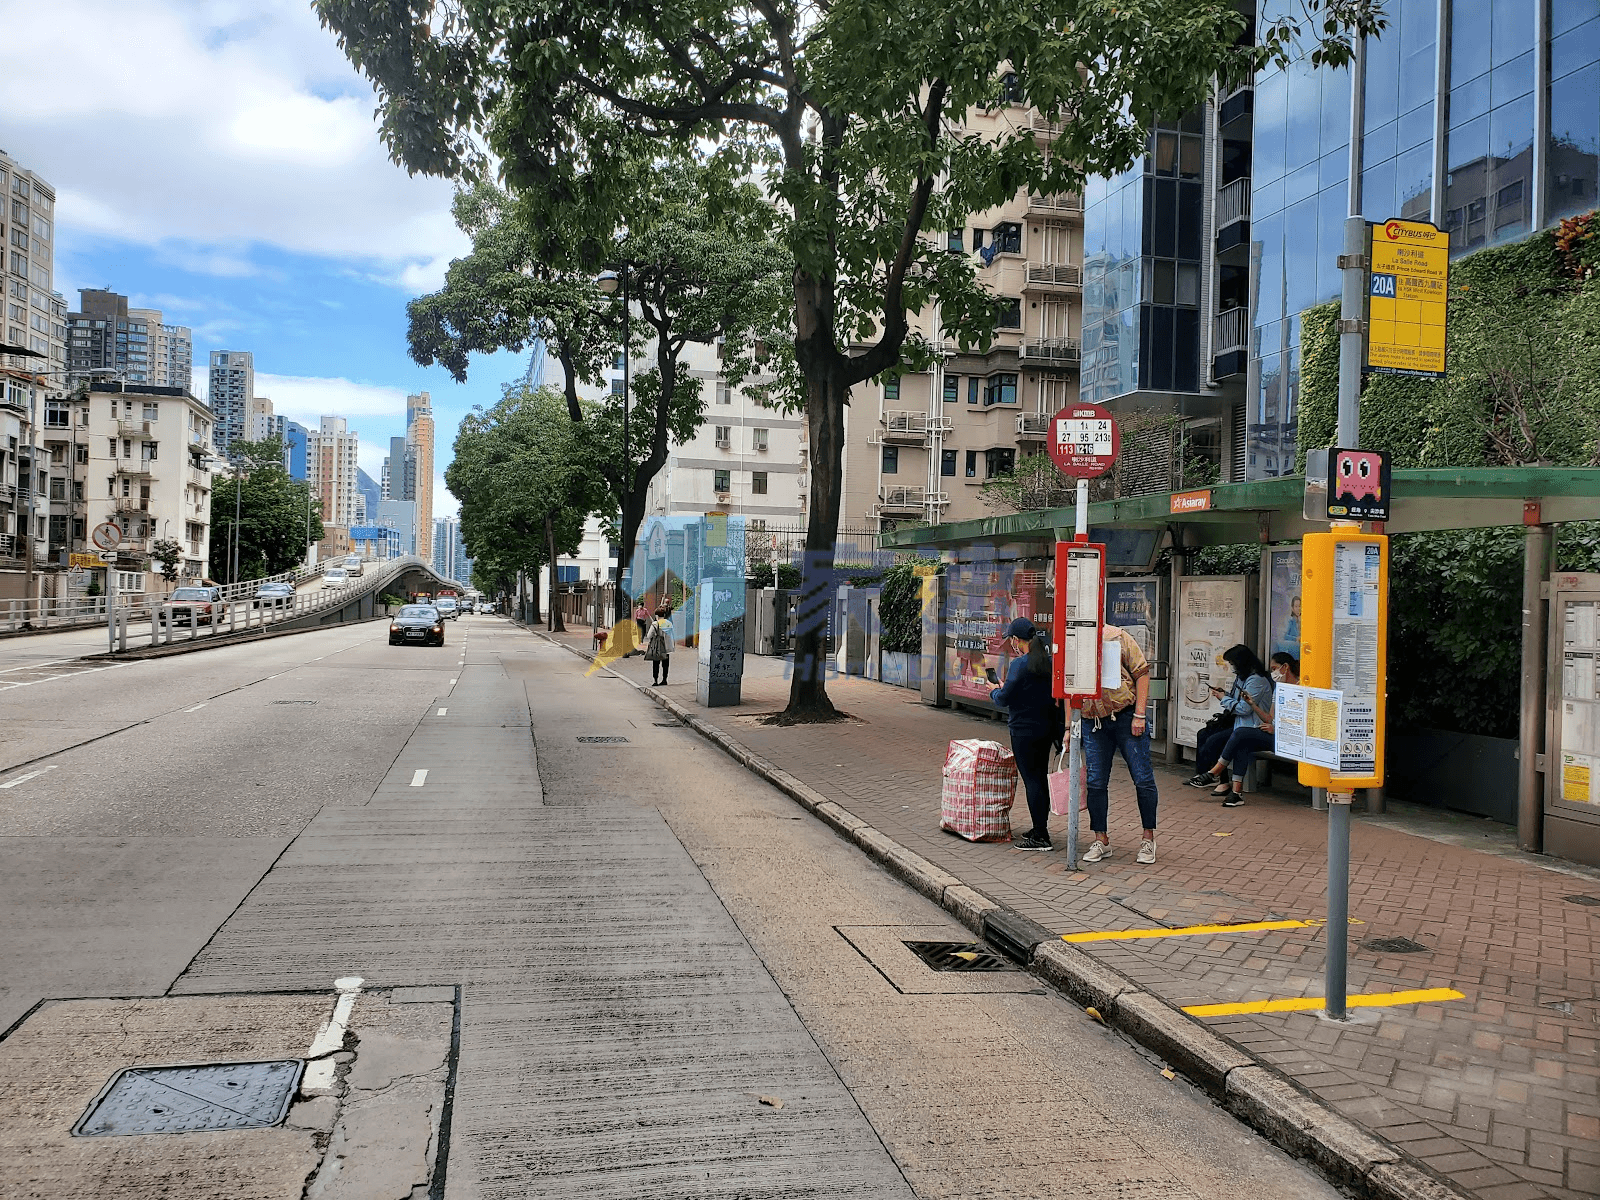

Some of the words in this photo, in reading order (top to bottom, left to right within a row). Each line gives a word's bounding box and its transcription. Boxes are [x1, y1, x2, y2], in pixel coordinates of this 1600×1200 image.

[1393, 228, 1422, 238] CITYBUS
[1372, 276, 1394, 295] 20A
[1064, 421, 1068, 430] 1
[1080, 421, 1088, 430] 1A
[1098, 421, 1106, 430] 24
[1062, 433, 1070, 442] 27
[1080, 433, 1089, 442] 95
[1094, 433, 1110, 442] 213D
[1060, 445, 1073, 454] 113
[1182, 497, 1206, 509] Asiaray
[1190, 652, 1207, 662] NAN
